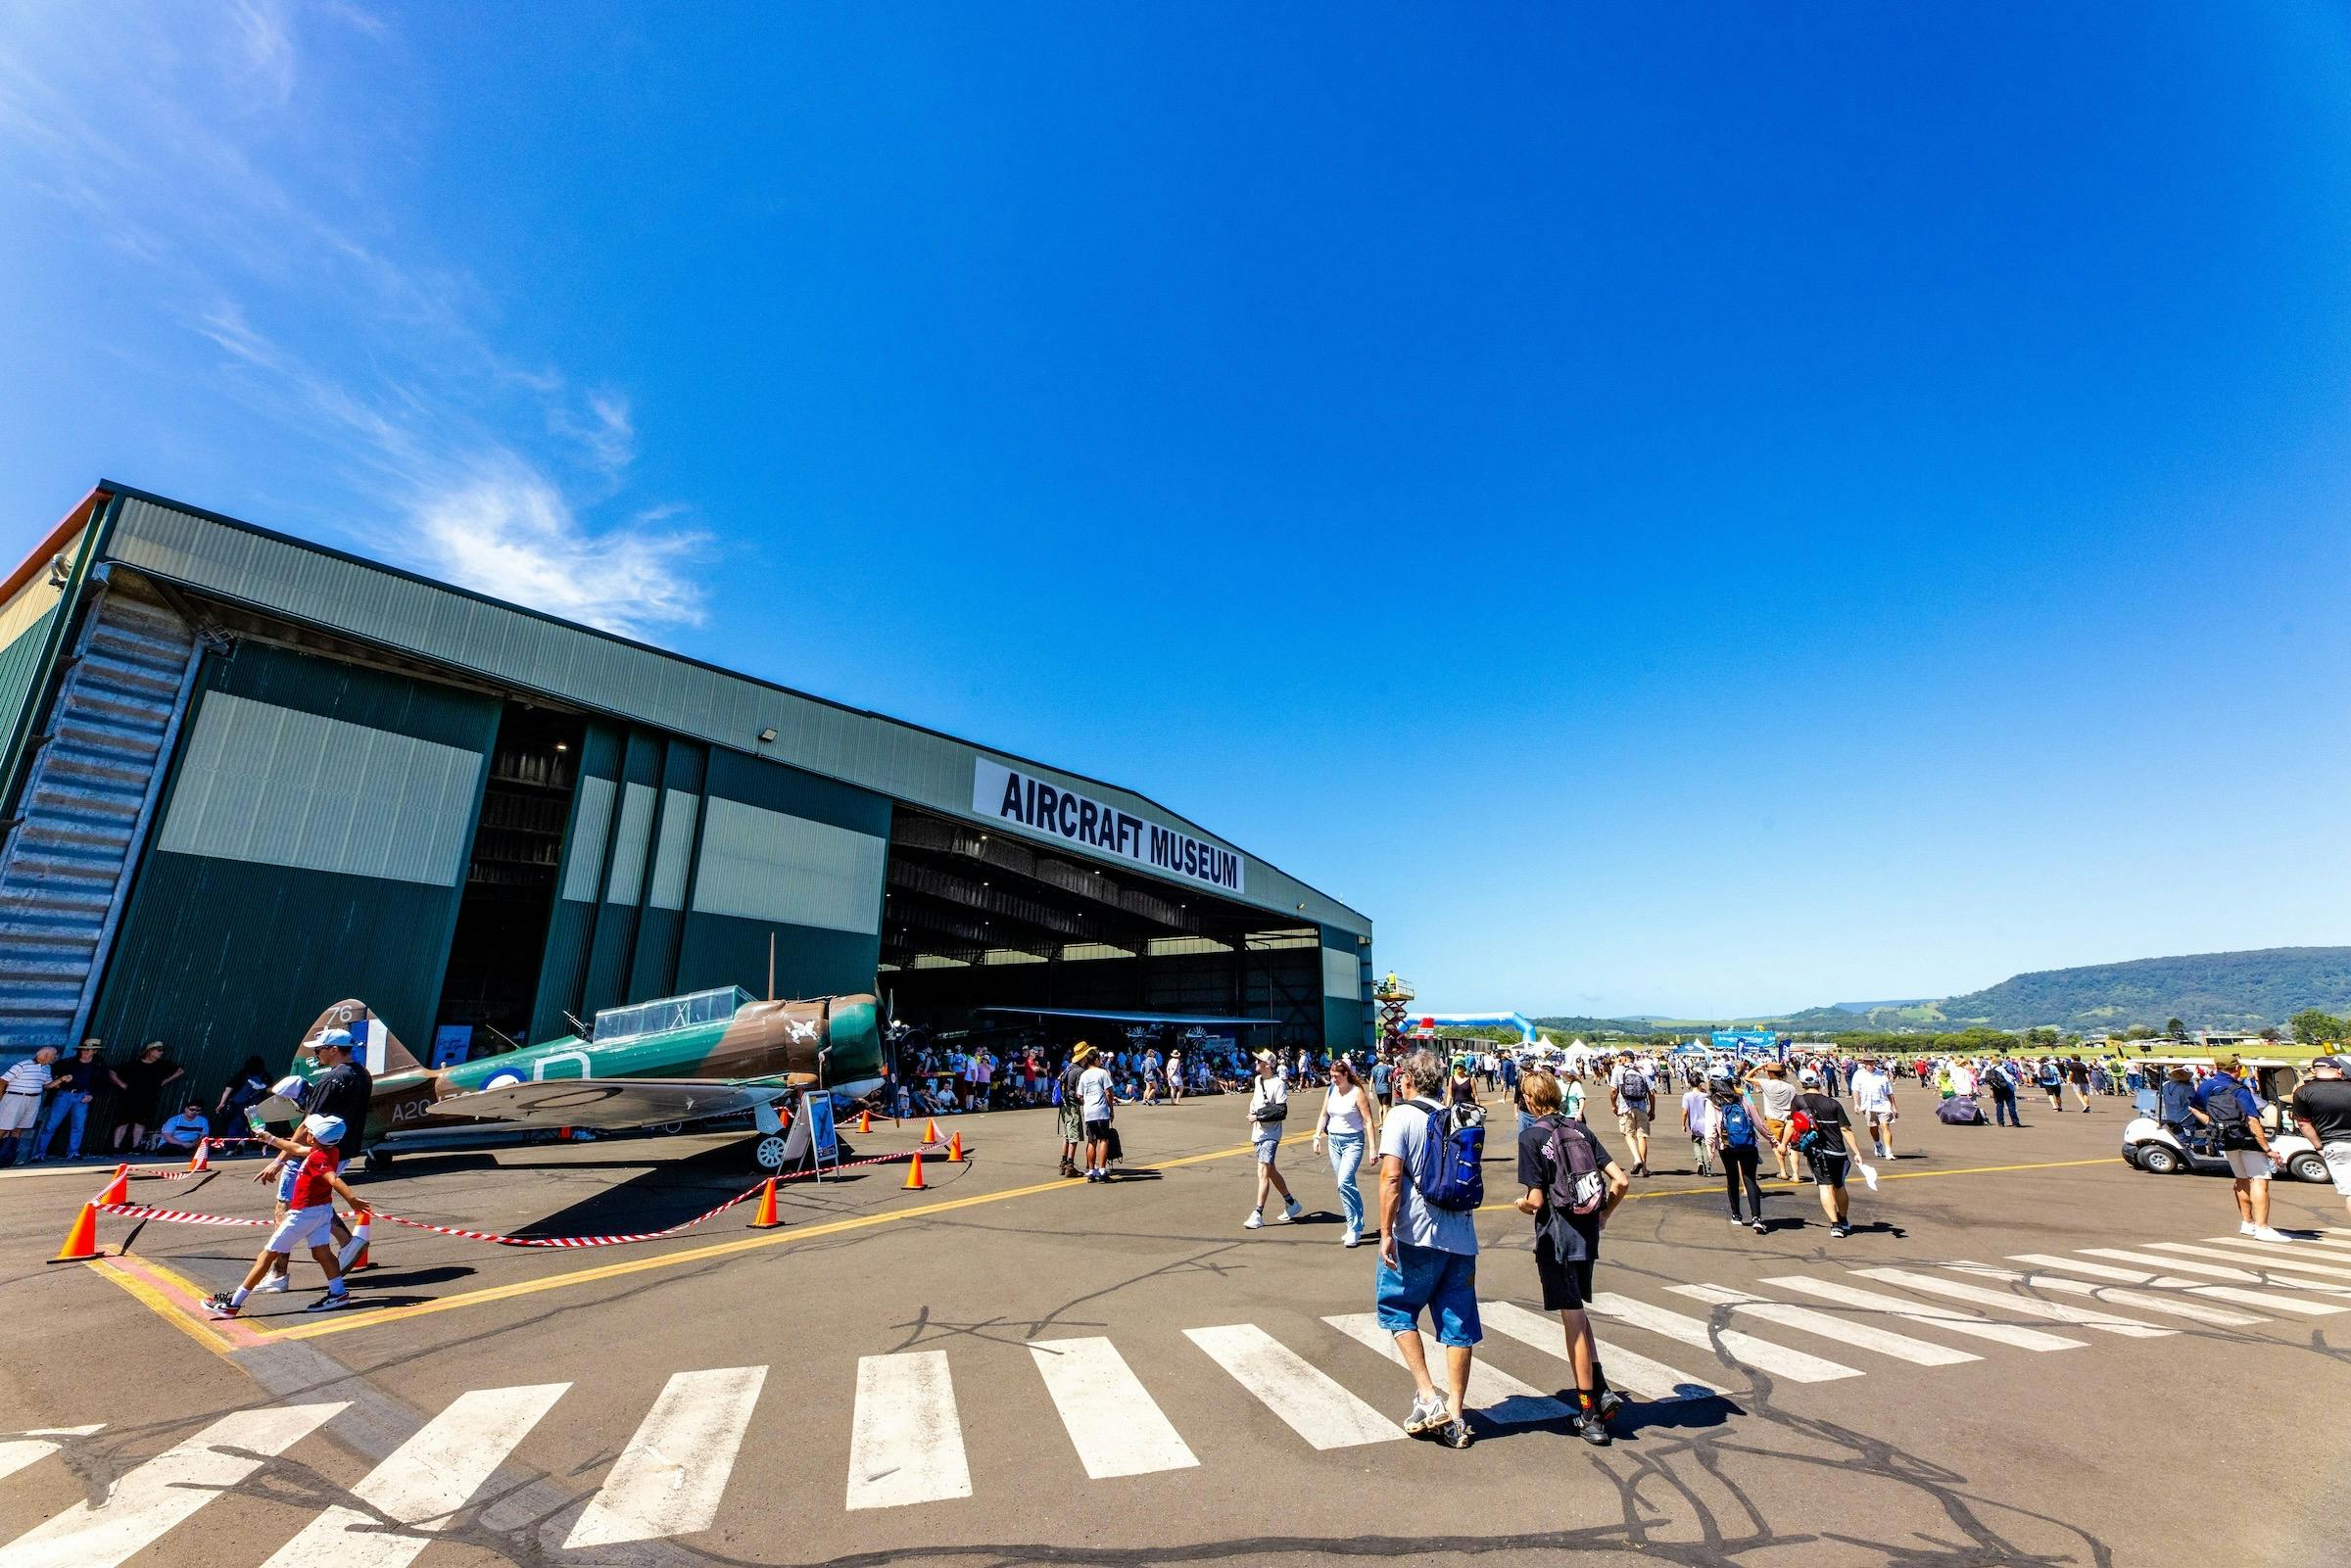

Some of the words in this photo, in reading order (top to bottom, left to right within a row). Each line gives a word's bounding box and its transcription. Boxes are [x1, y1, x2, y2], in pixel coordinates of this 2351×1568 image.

[1000, 772, 1143, 859] AIRCRAFT
[1150, 825, 1237, 889] MUSEUM
[327, 1005, 353, 1025] 76
[1574, 1170, 1603, 1205] NIKE
